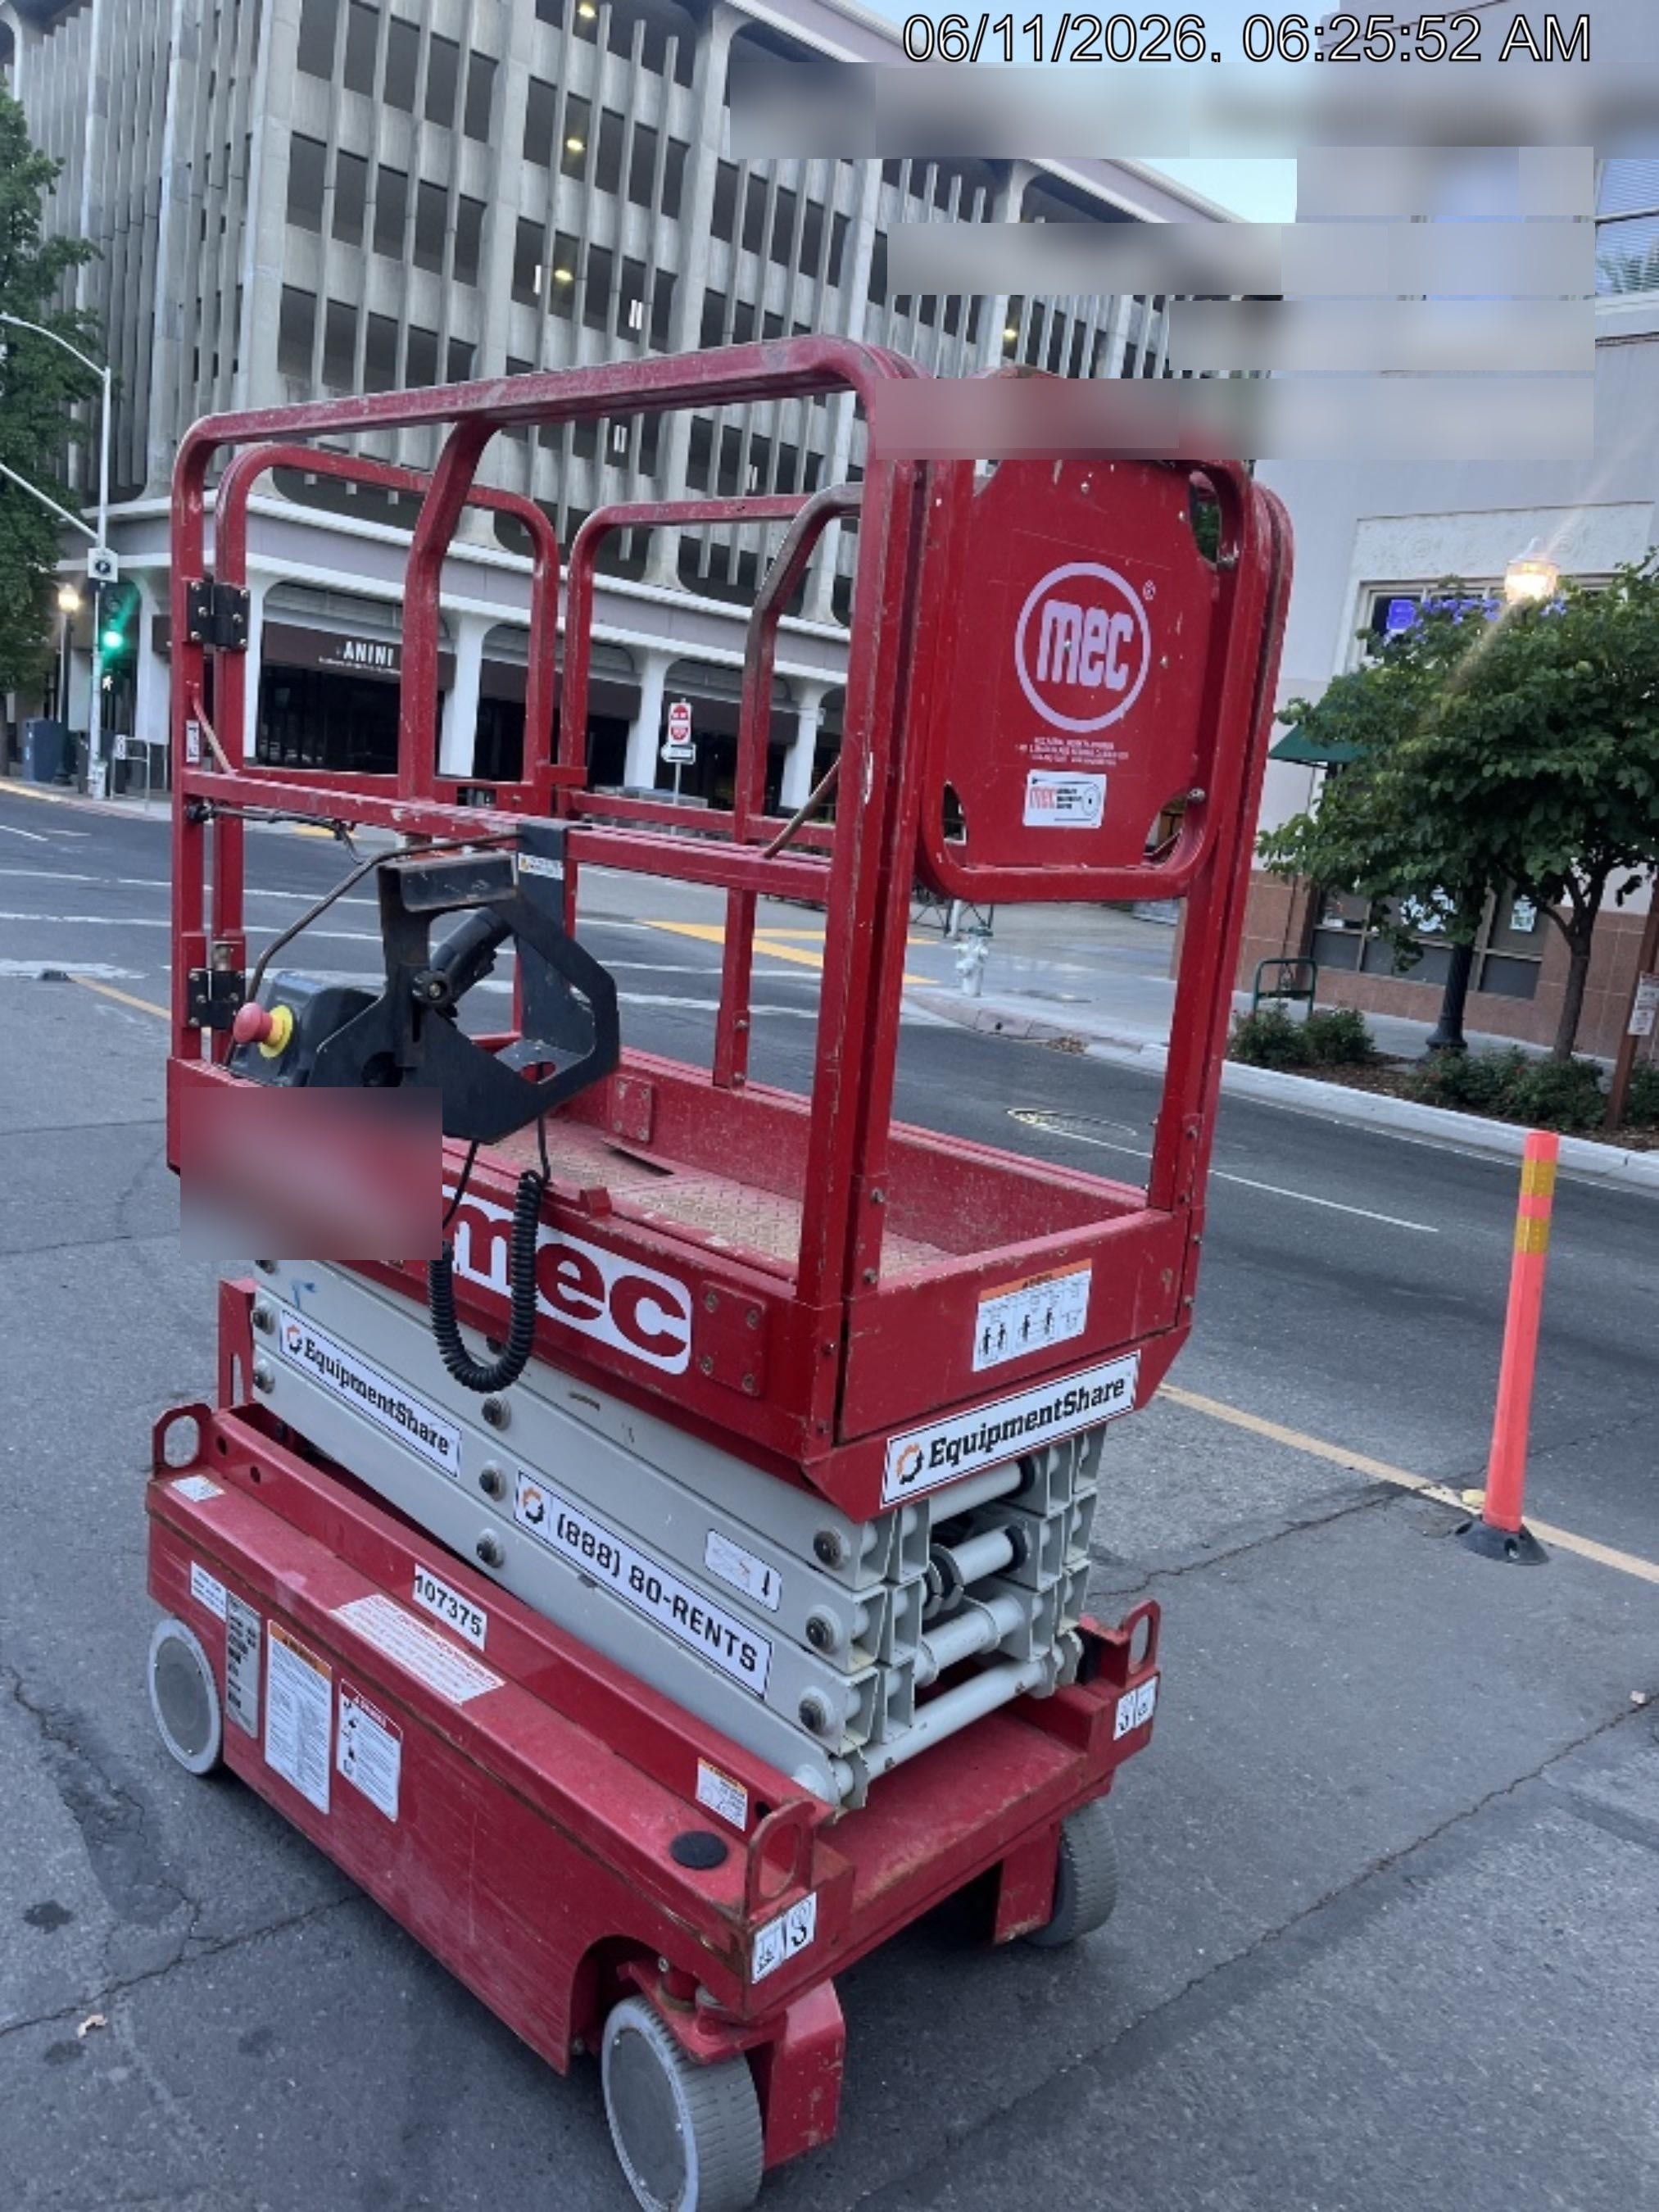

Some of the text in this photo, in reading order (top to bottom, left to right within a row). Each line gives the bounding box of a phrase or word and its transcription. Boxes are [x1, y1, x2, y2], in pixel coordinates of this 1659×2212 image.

[303, 1336, 451, 1457] EquipmentShare
[928, 1377, 1125, 1469] EquipmentShare
[415, 1575, 483, 1637] 107375
[557, 1513, 620, 1578] (888)
[628, 1562, 758, 1673] 80-RENTS
